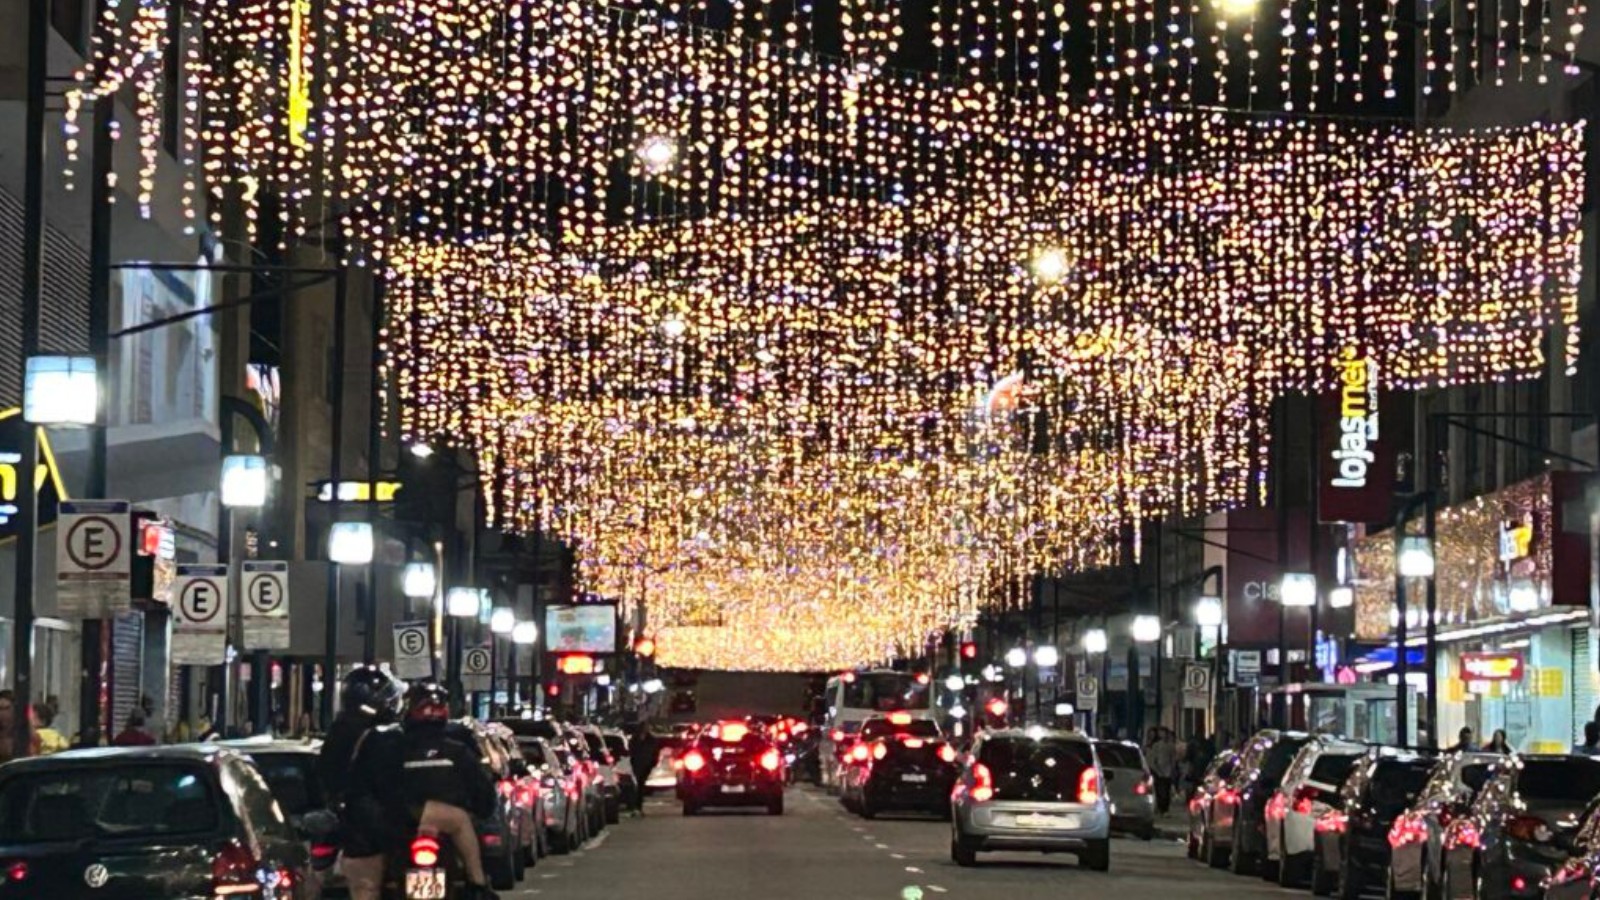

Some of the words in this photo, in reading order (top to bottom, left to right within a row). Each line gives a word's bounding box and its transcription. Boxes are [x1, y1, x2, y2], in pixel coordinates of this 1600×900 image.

[84, 527, 104, 558] E
[192, 587, 209, 613] E
[258, 581, 273, 604] E
[1243, 581, 1283, 600] Cla
[405, 634, 417, 652] E
